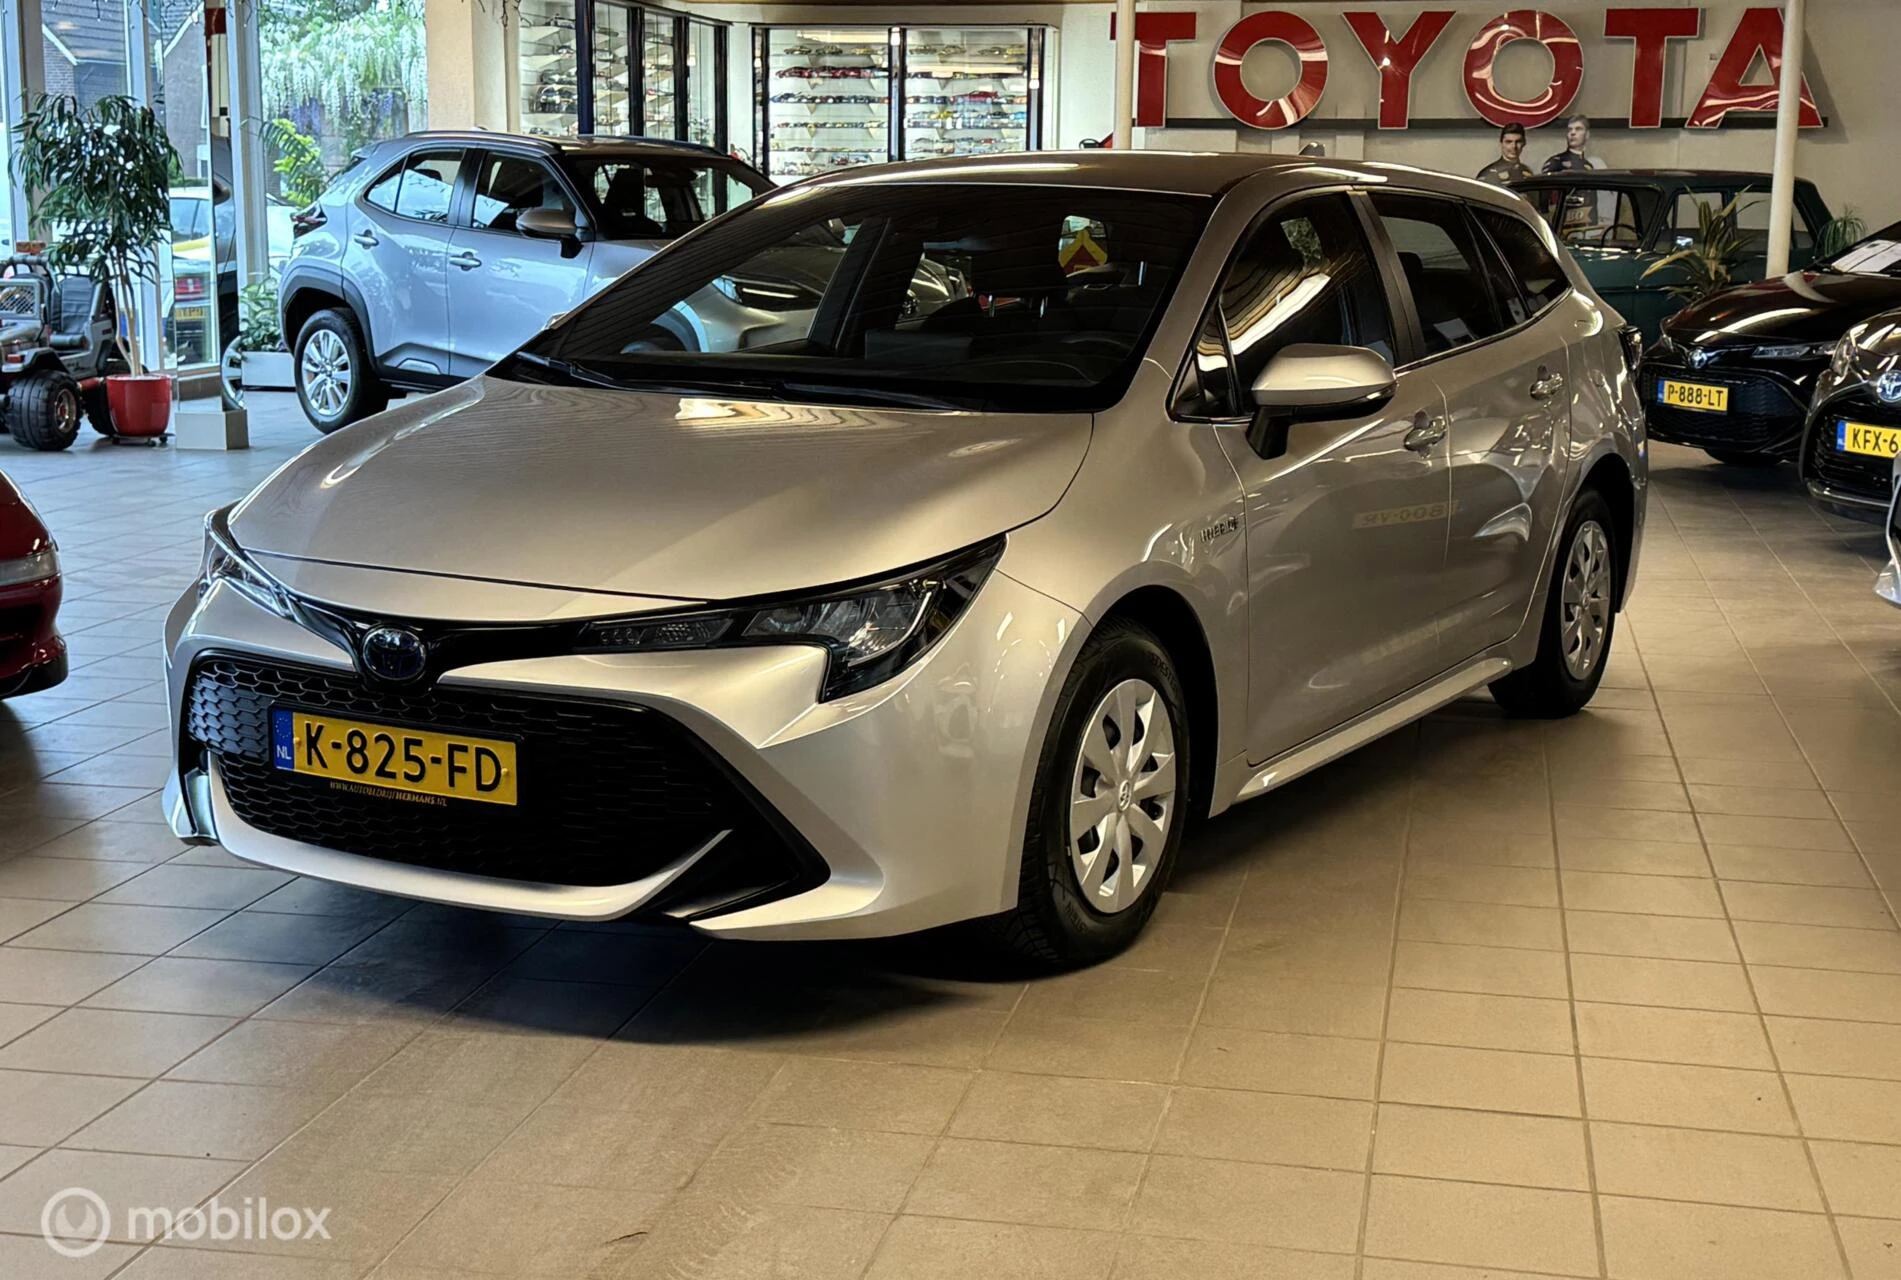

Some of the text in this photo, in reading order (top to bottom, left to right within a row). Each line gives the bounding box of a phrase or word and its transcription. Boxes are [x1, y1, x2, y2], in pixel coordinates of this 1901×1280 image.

[1110, 8, 1824, 130] TOYOTA
[1667, 383, 1724, 407] P-888-LT
[276, 744, 292, 760] NL
[304, 721, 502, 792] K-825-FD
